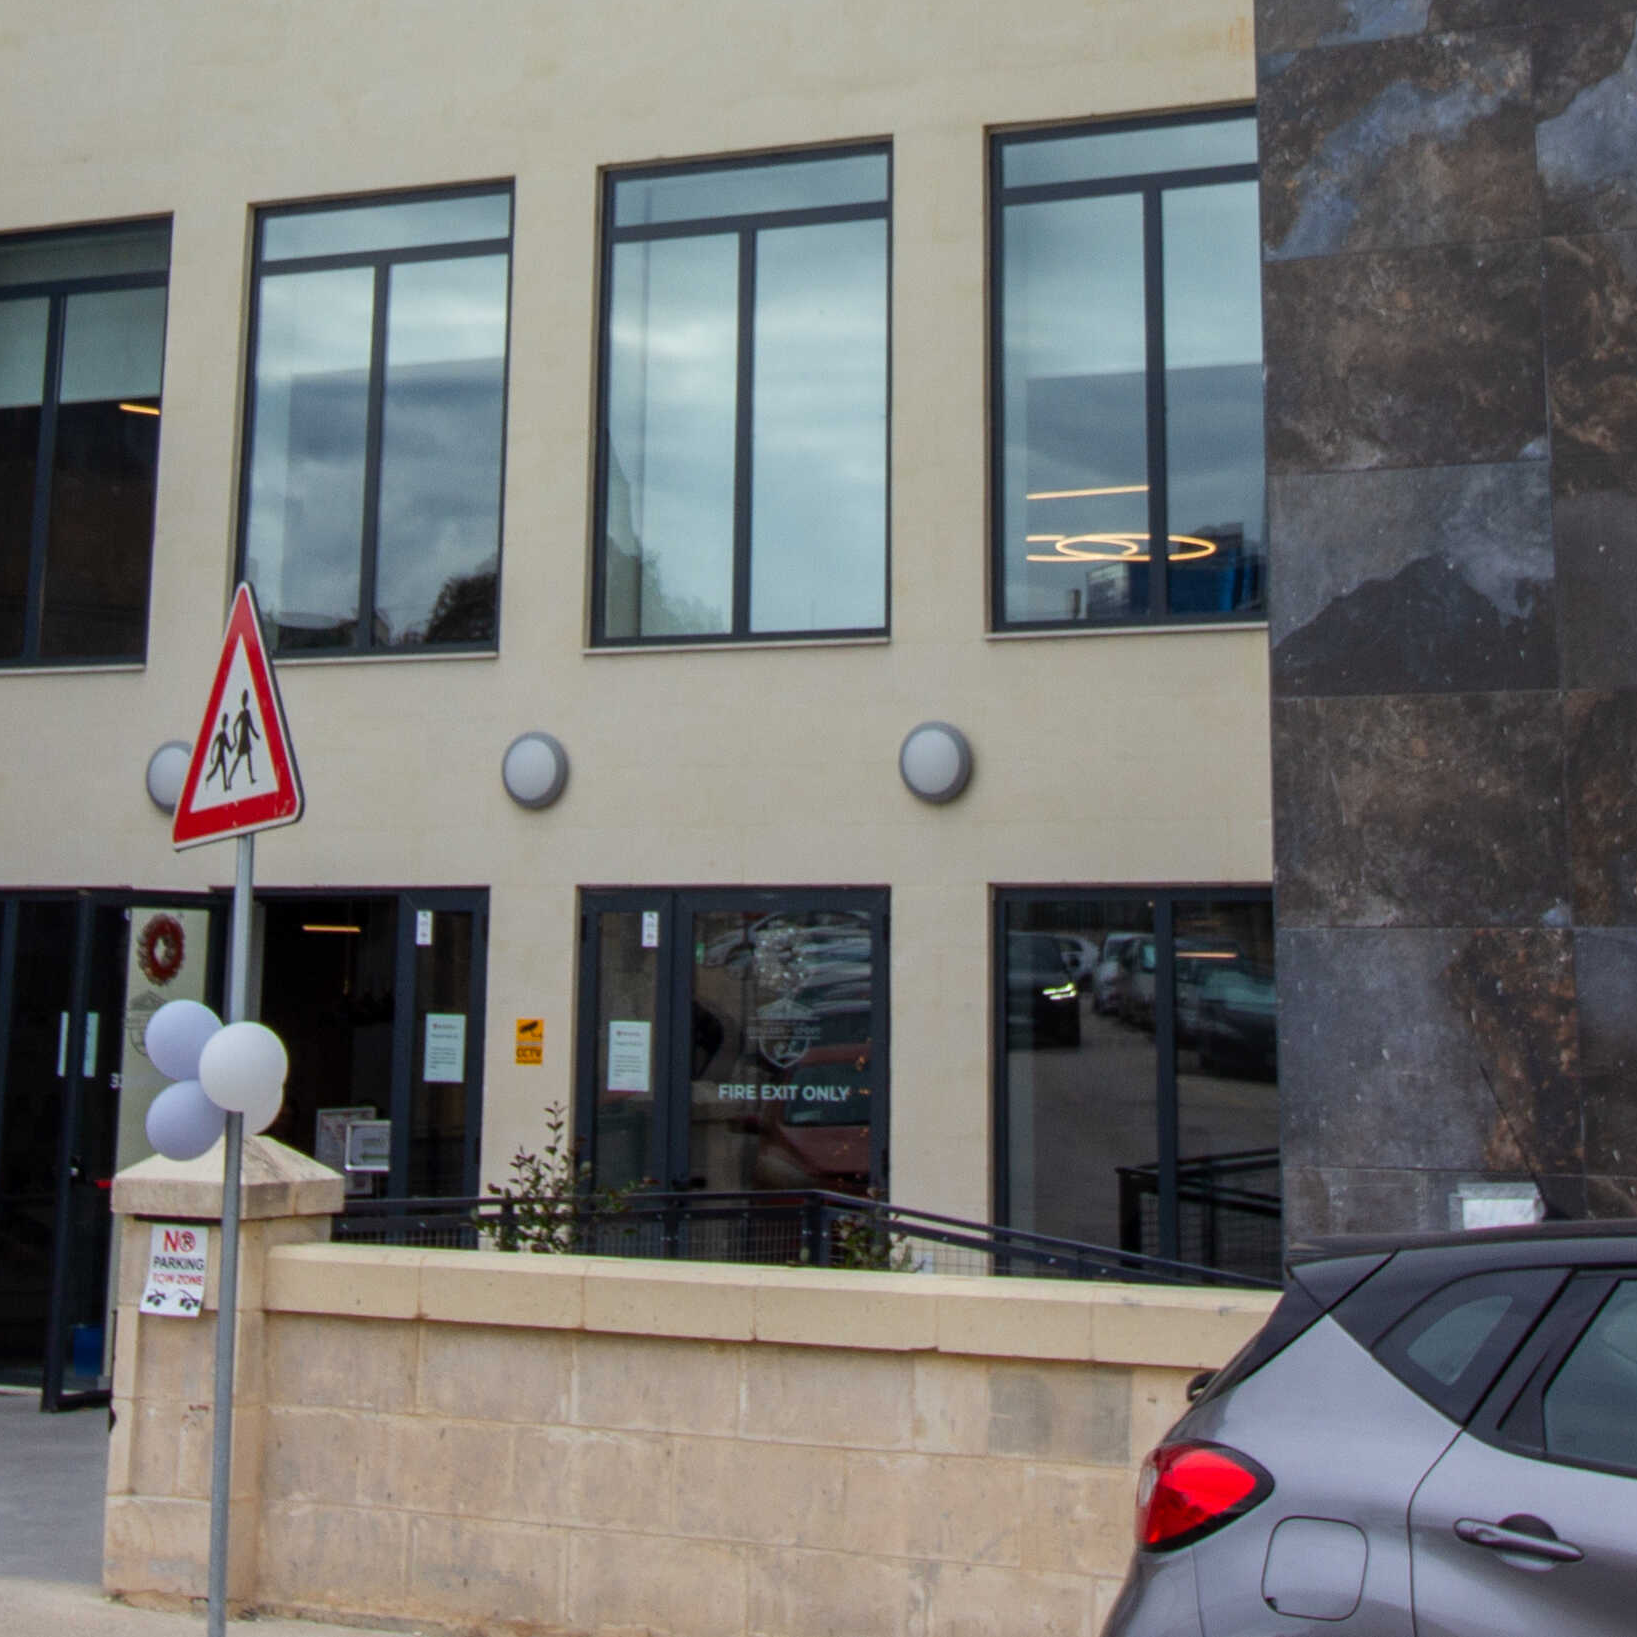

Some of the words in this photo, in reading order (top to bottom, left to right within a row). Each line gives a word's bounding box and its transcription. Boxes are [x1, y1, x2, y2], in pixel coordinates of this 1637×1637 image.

[717, 1083, 758, 1101] FIRE
[760, 1084, 799, 1101] EXIT
[801, 1085, 851, 1102] ONLY
[153, 1255, 205, 1271] PARKING
[153, 1272, 175, 1285] TOW
[177, 1273, 205, 1286] ZONE
